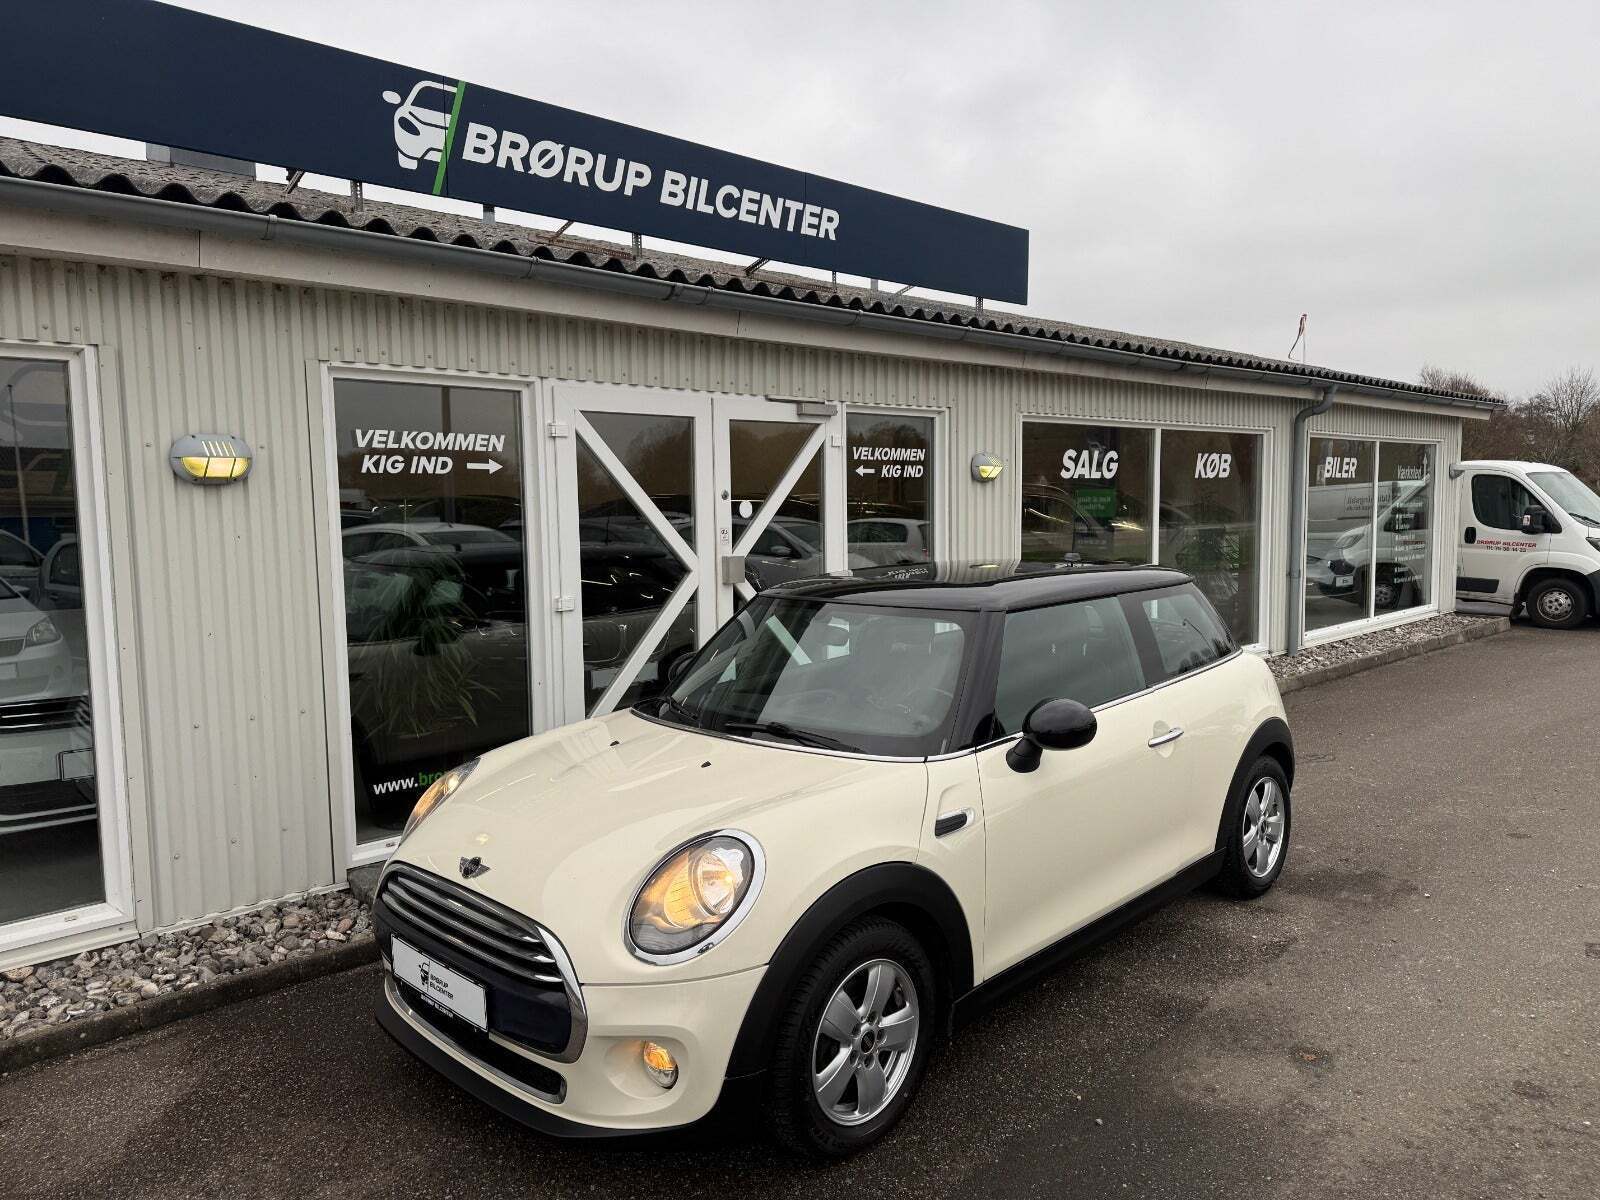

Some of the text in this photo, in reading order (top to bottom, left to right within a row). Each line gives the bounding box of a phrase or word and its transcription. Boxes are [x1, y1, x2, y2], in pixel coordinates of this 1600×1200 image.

[461, 122, 840, 241] BRØRUP BILCENTER
[355, 428, 505, 452] VELKOMMEN
[361, 454, 454, 475] KIG IND
[852, 446, 926, 461] VELKOMMEN
[1060, 448, 1119, 479] SALG
[881, 464, 924, 478] KIG IND
[1194, 452, 1232, 479] KØB
[1324, 456, 1358, 478] BILER
